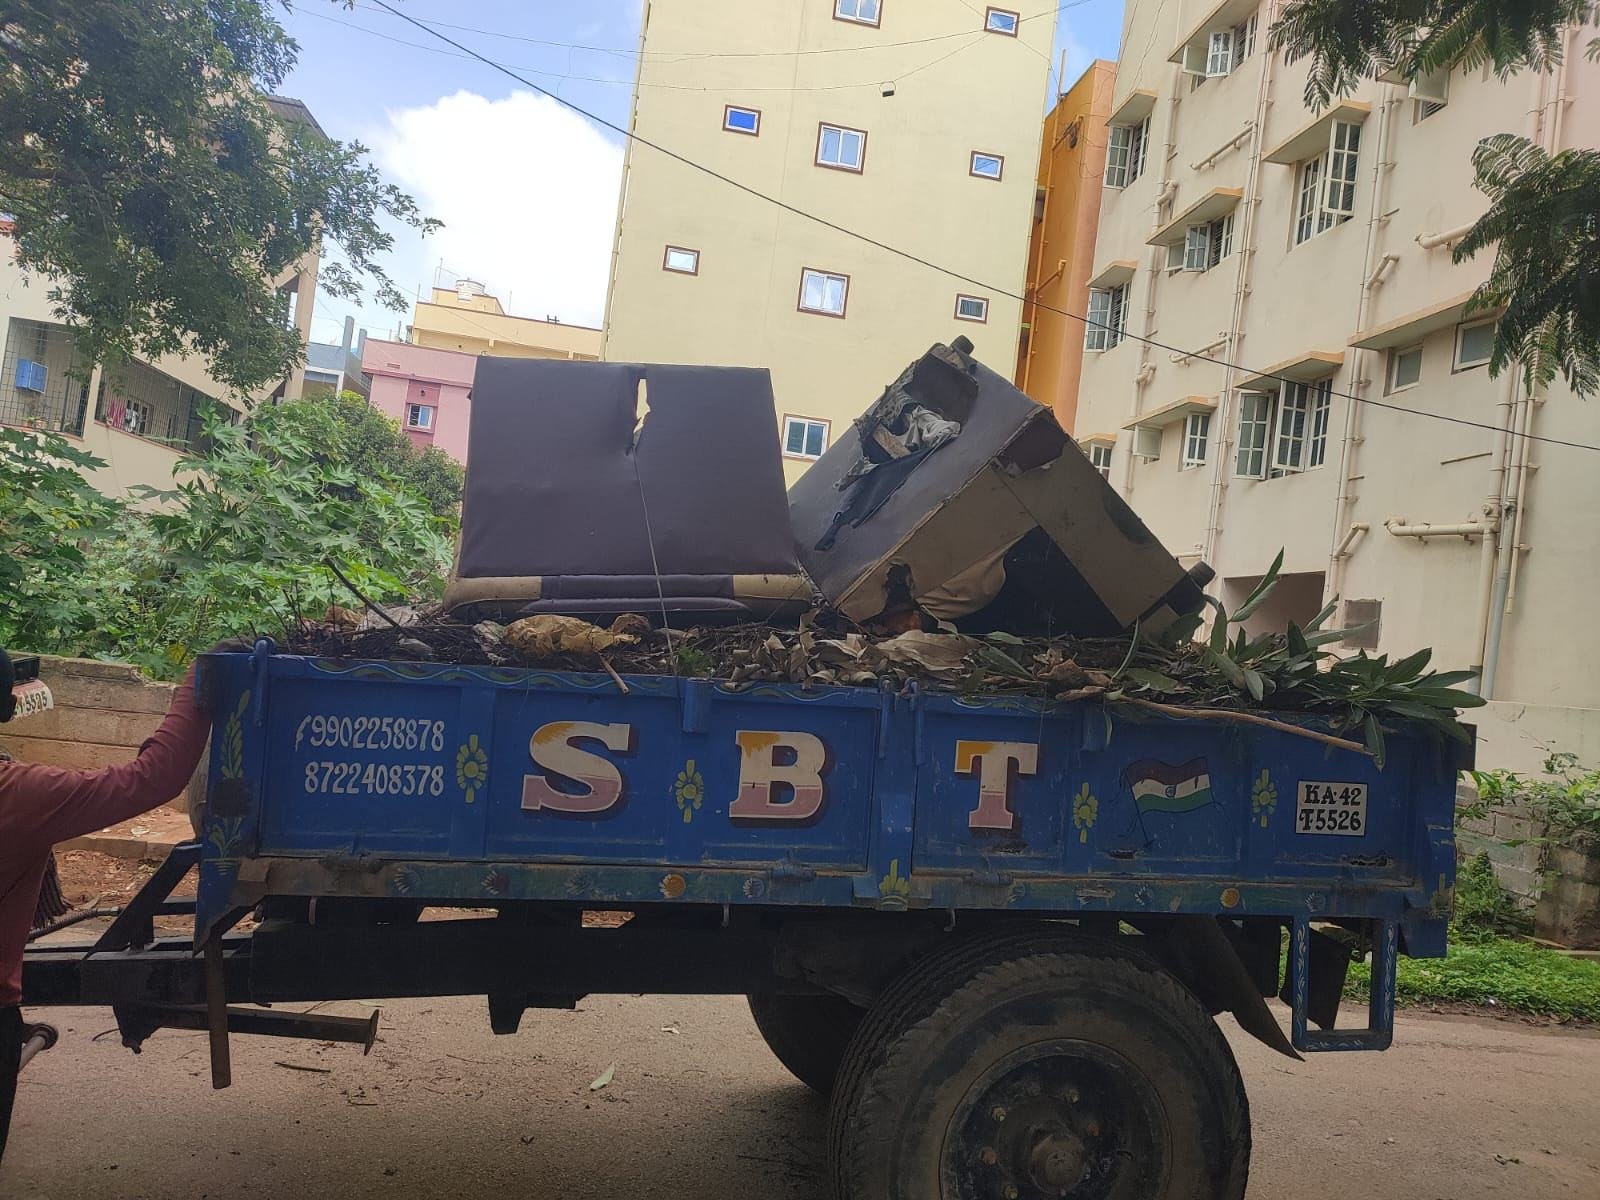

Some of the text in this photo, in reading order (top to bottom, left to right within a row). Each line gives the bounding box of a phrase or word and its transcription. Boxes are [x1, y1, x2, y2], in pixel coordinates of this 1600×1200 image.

[310, 715, 445, 751] 9902258878
[304, 761, 444, 796] 8722408378
[521, 720, 1038, 829] S B T
